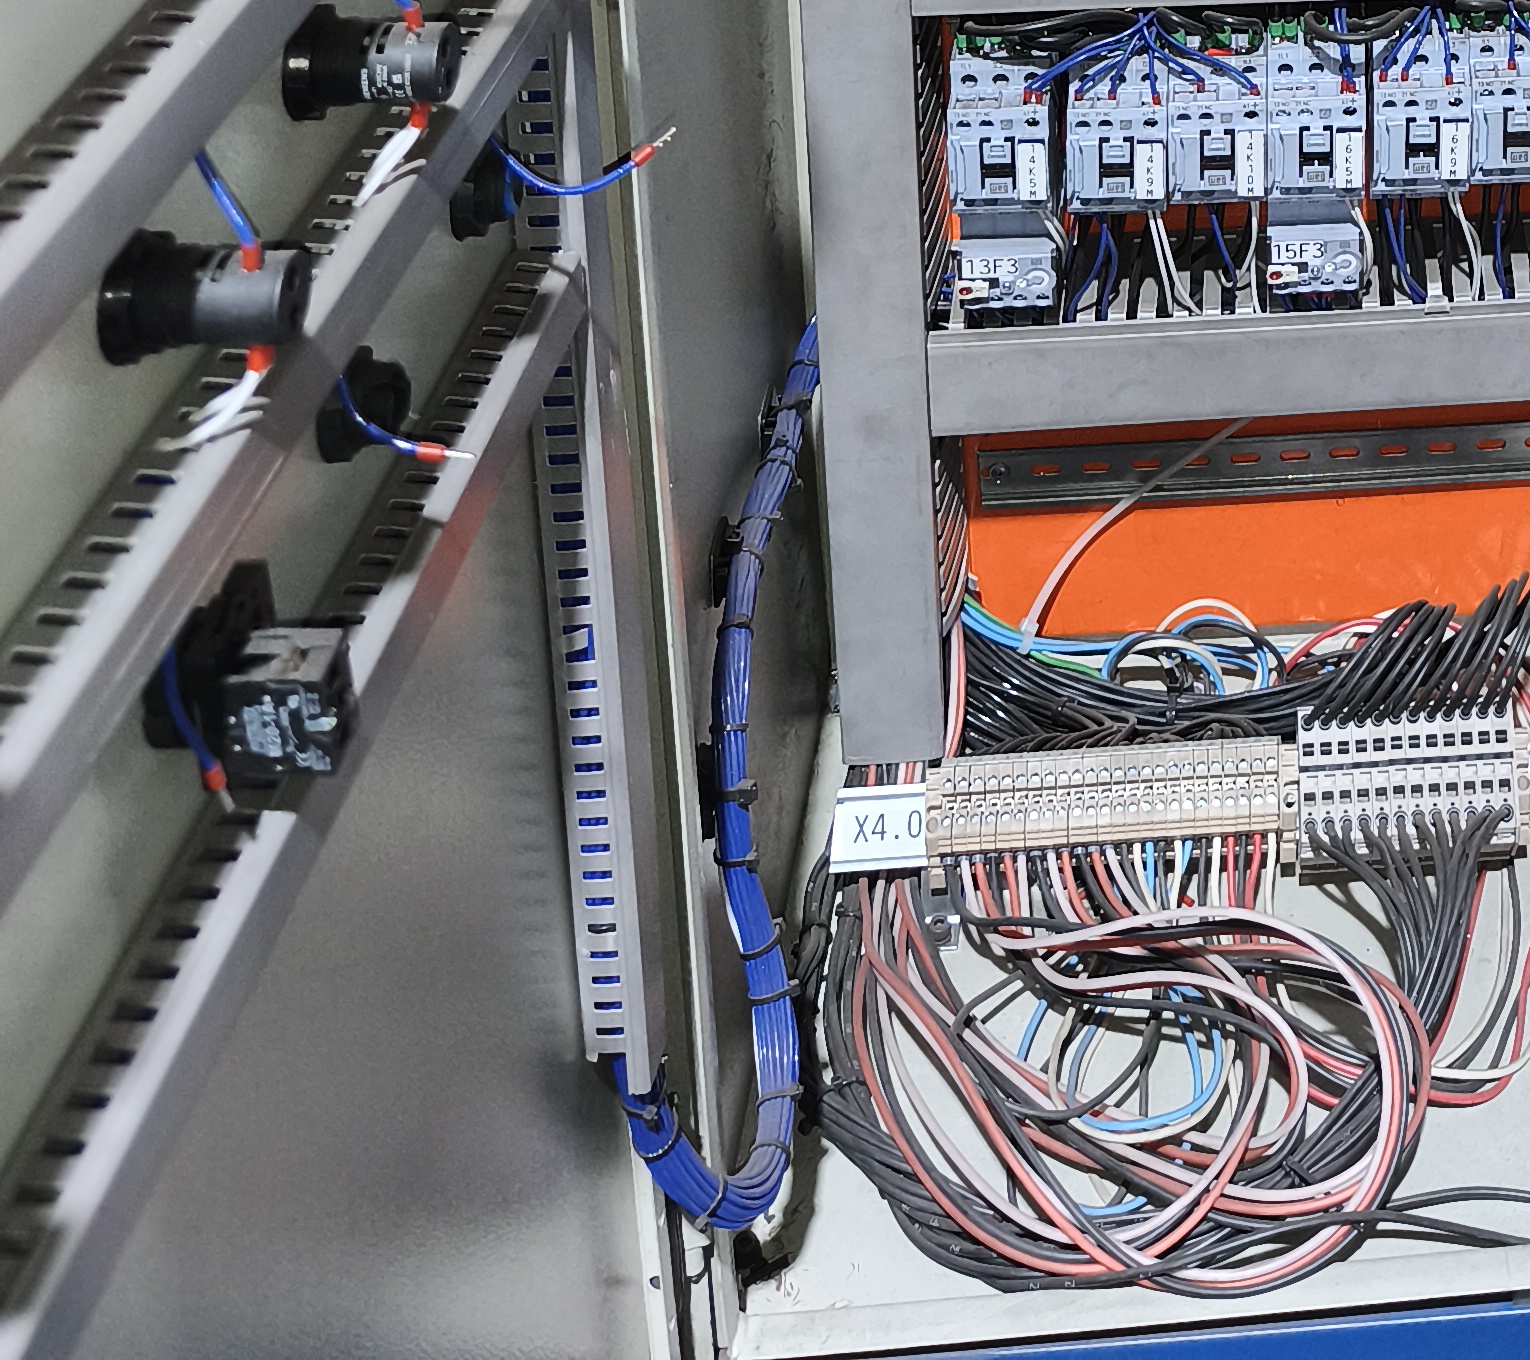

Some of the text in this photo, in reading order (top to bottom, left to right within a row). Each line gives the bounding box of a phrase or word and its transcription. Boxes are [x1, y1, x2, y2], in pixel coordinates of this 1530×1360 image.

[1028, 144, 1037, 198] 14K5M
[1146, 144, 1154, 198] 14K9M
[1246, 131, 1254, 195] 14K10M
[1345, 134, 1353, 188] 16K5M
[1449, 123, 1459, 178] 16K9M
[965, 258, 1019, 275] 13F3
[1273, 243, 1324, 259] 15F3
[853, 809, 923, 844] X4.0
